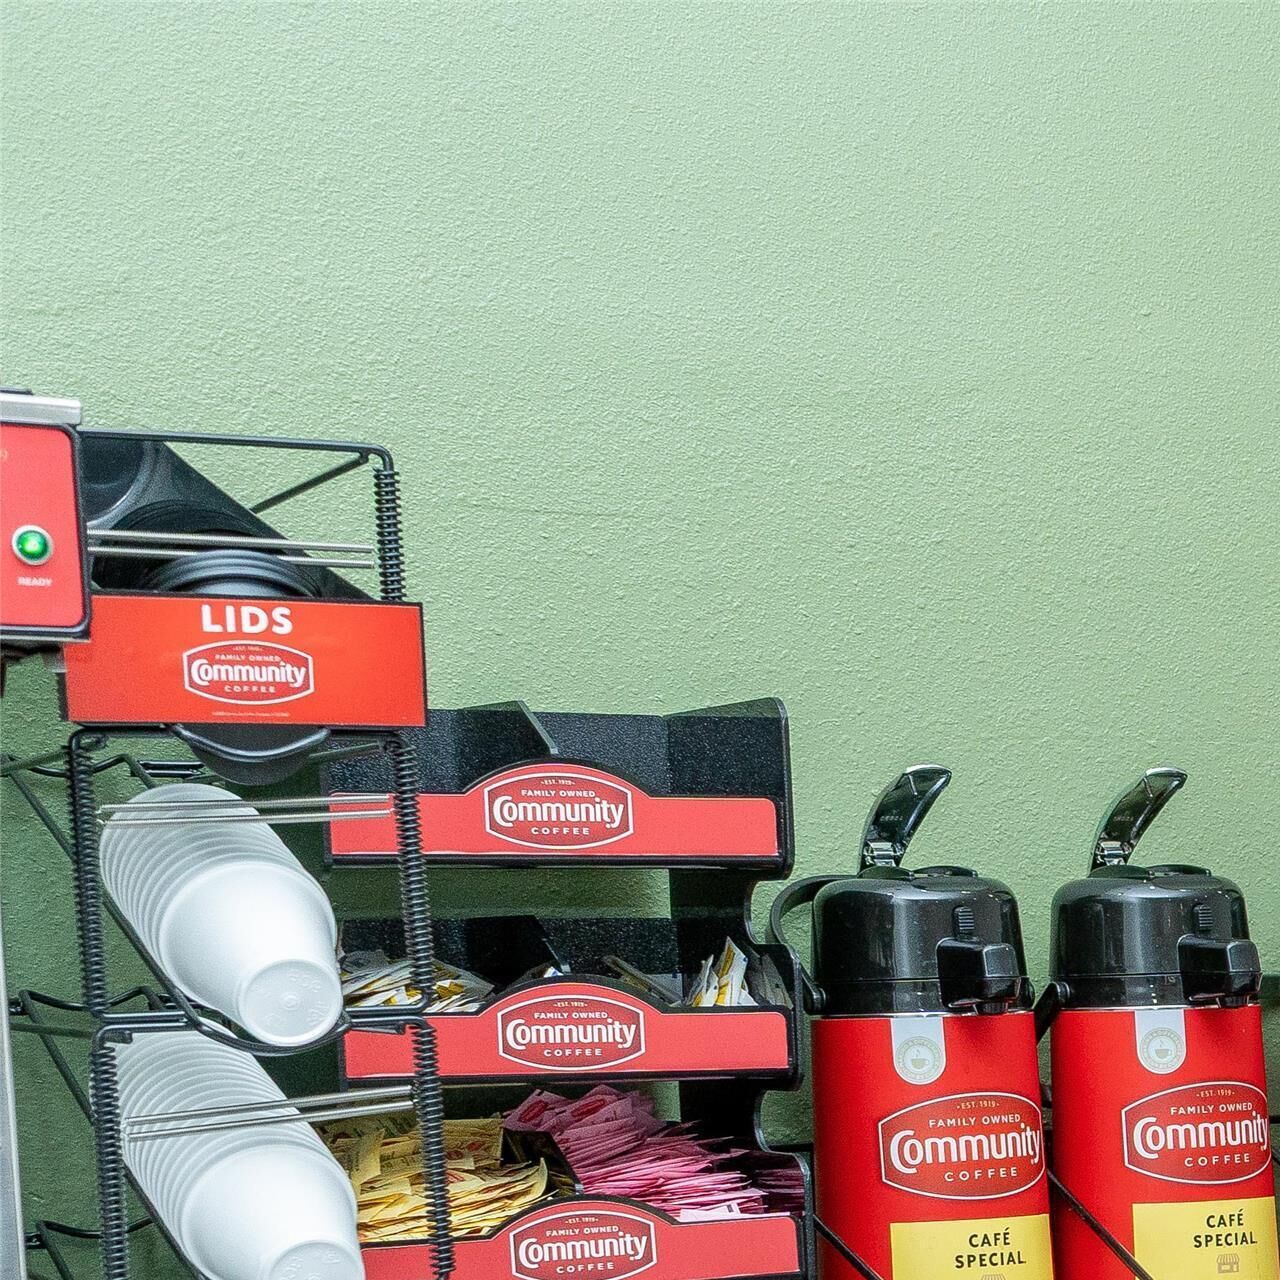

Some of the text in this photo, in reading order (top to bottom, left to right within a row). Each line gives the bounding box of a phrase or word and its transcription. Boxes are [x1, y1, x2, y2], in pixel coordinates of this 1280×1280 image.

[201, 604, 293, 635] LIDS
[191, 659, 307, 688] Community
[224, 685, 276, 694] COFFEE
[559, 790, 595, 798] OWNED
[493, 796, 624, 829] Community
[531, 827, 590, 835] COFFEE
[506, 1018, 636, 1050] Community
[1200, 1090, 1216, 1098] EST.
[961, 1102, 977, 1110] EST.
[1170, 1102, 1252, 1115] FAMILY OWNED
[928, 1114, 1021, 1128] FAMILY OWNED
[1133, 1111, 1268, 1160] Community
[890, 1123, 1040, 1174] Community
[1184, 1153, 1250, 1167] COFFEE
[944, 1166, 1017, 1182] COFFEE
[1206, 1209, 1244, 1229] CAFÉ
[546, 1225, 619, 1237] FAMILY OWNED
[968, 1227, 1011, 1248] CAFÉ
[1193, 1231, 1257, 1249] SPECIAL
[519, 1231, 648, 1269] Community
[556, 1262, 615, 1274] COFFEE
[955, 1250, 1026, 1269] SPECIAL
